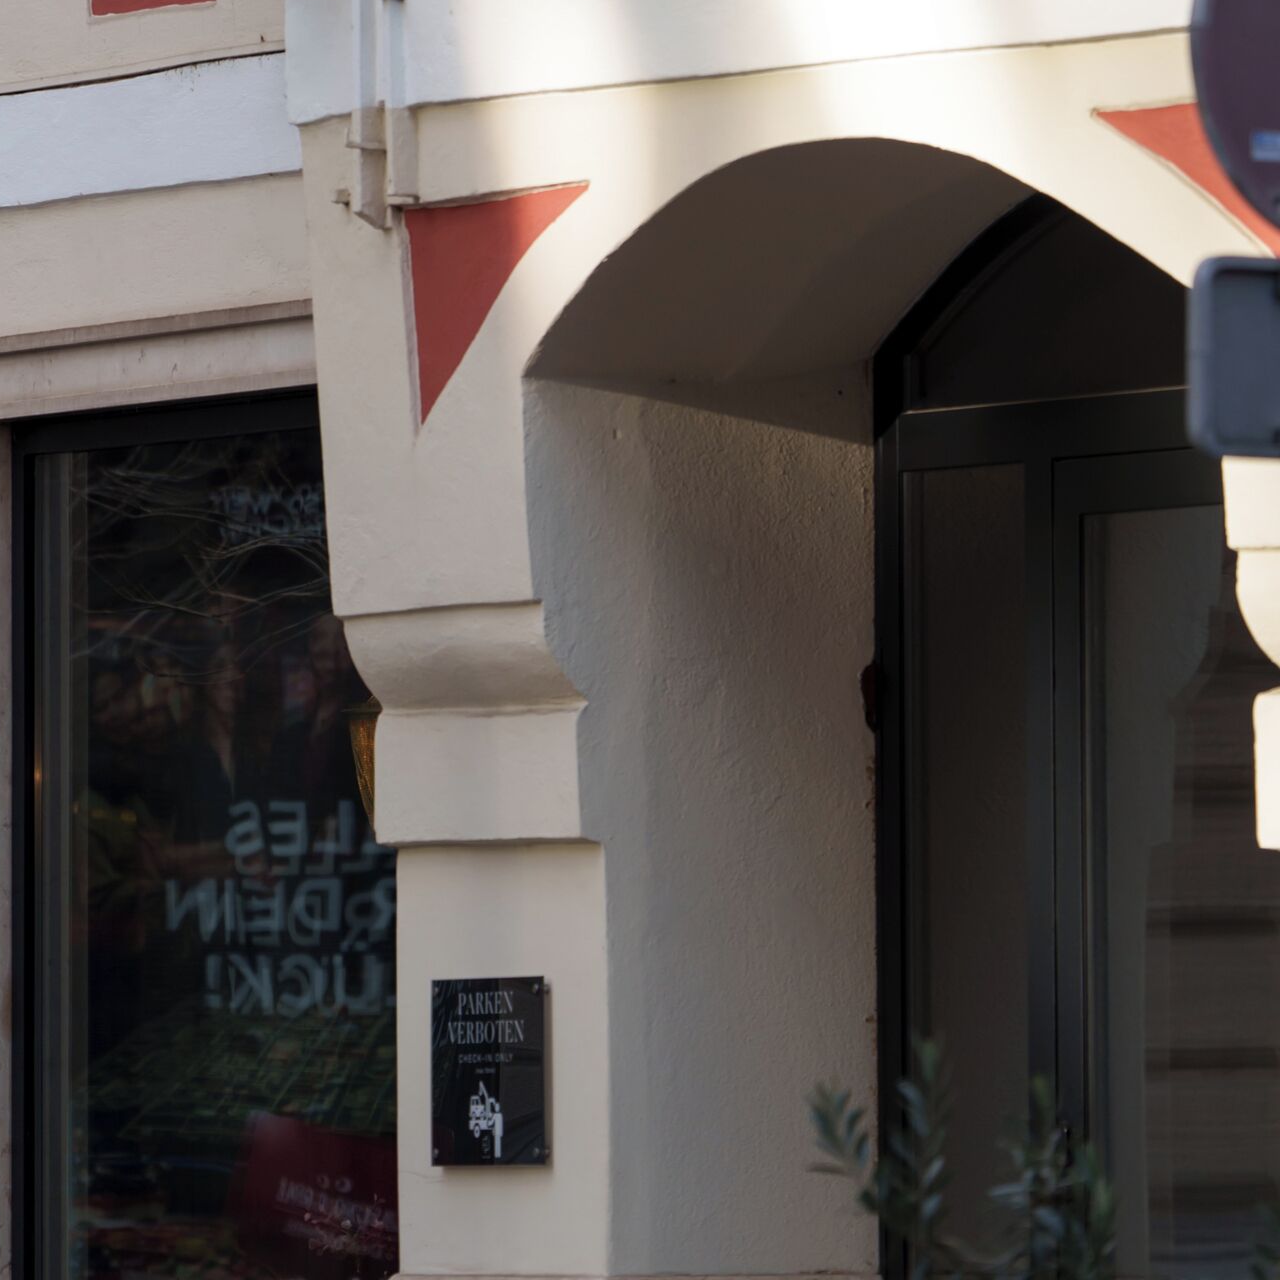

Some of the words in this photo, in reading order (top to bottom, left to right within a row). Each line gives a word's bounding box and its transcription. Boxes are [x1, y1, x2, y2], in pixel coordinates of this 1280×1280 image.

[457, 991, 514, 1016] PARKEN
[447, 1020, 525, 1045] VERBOTEN
[458, 1054, 493, 1063] CHECK-IN
